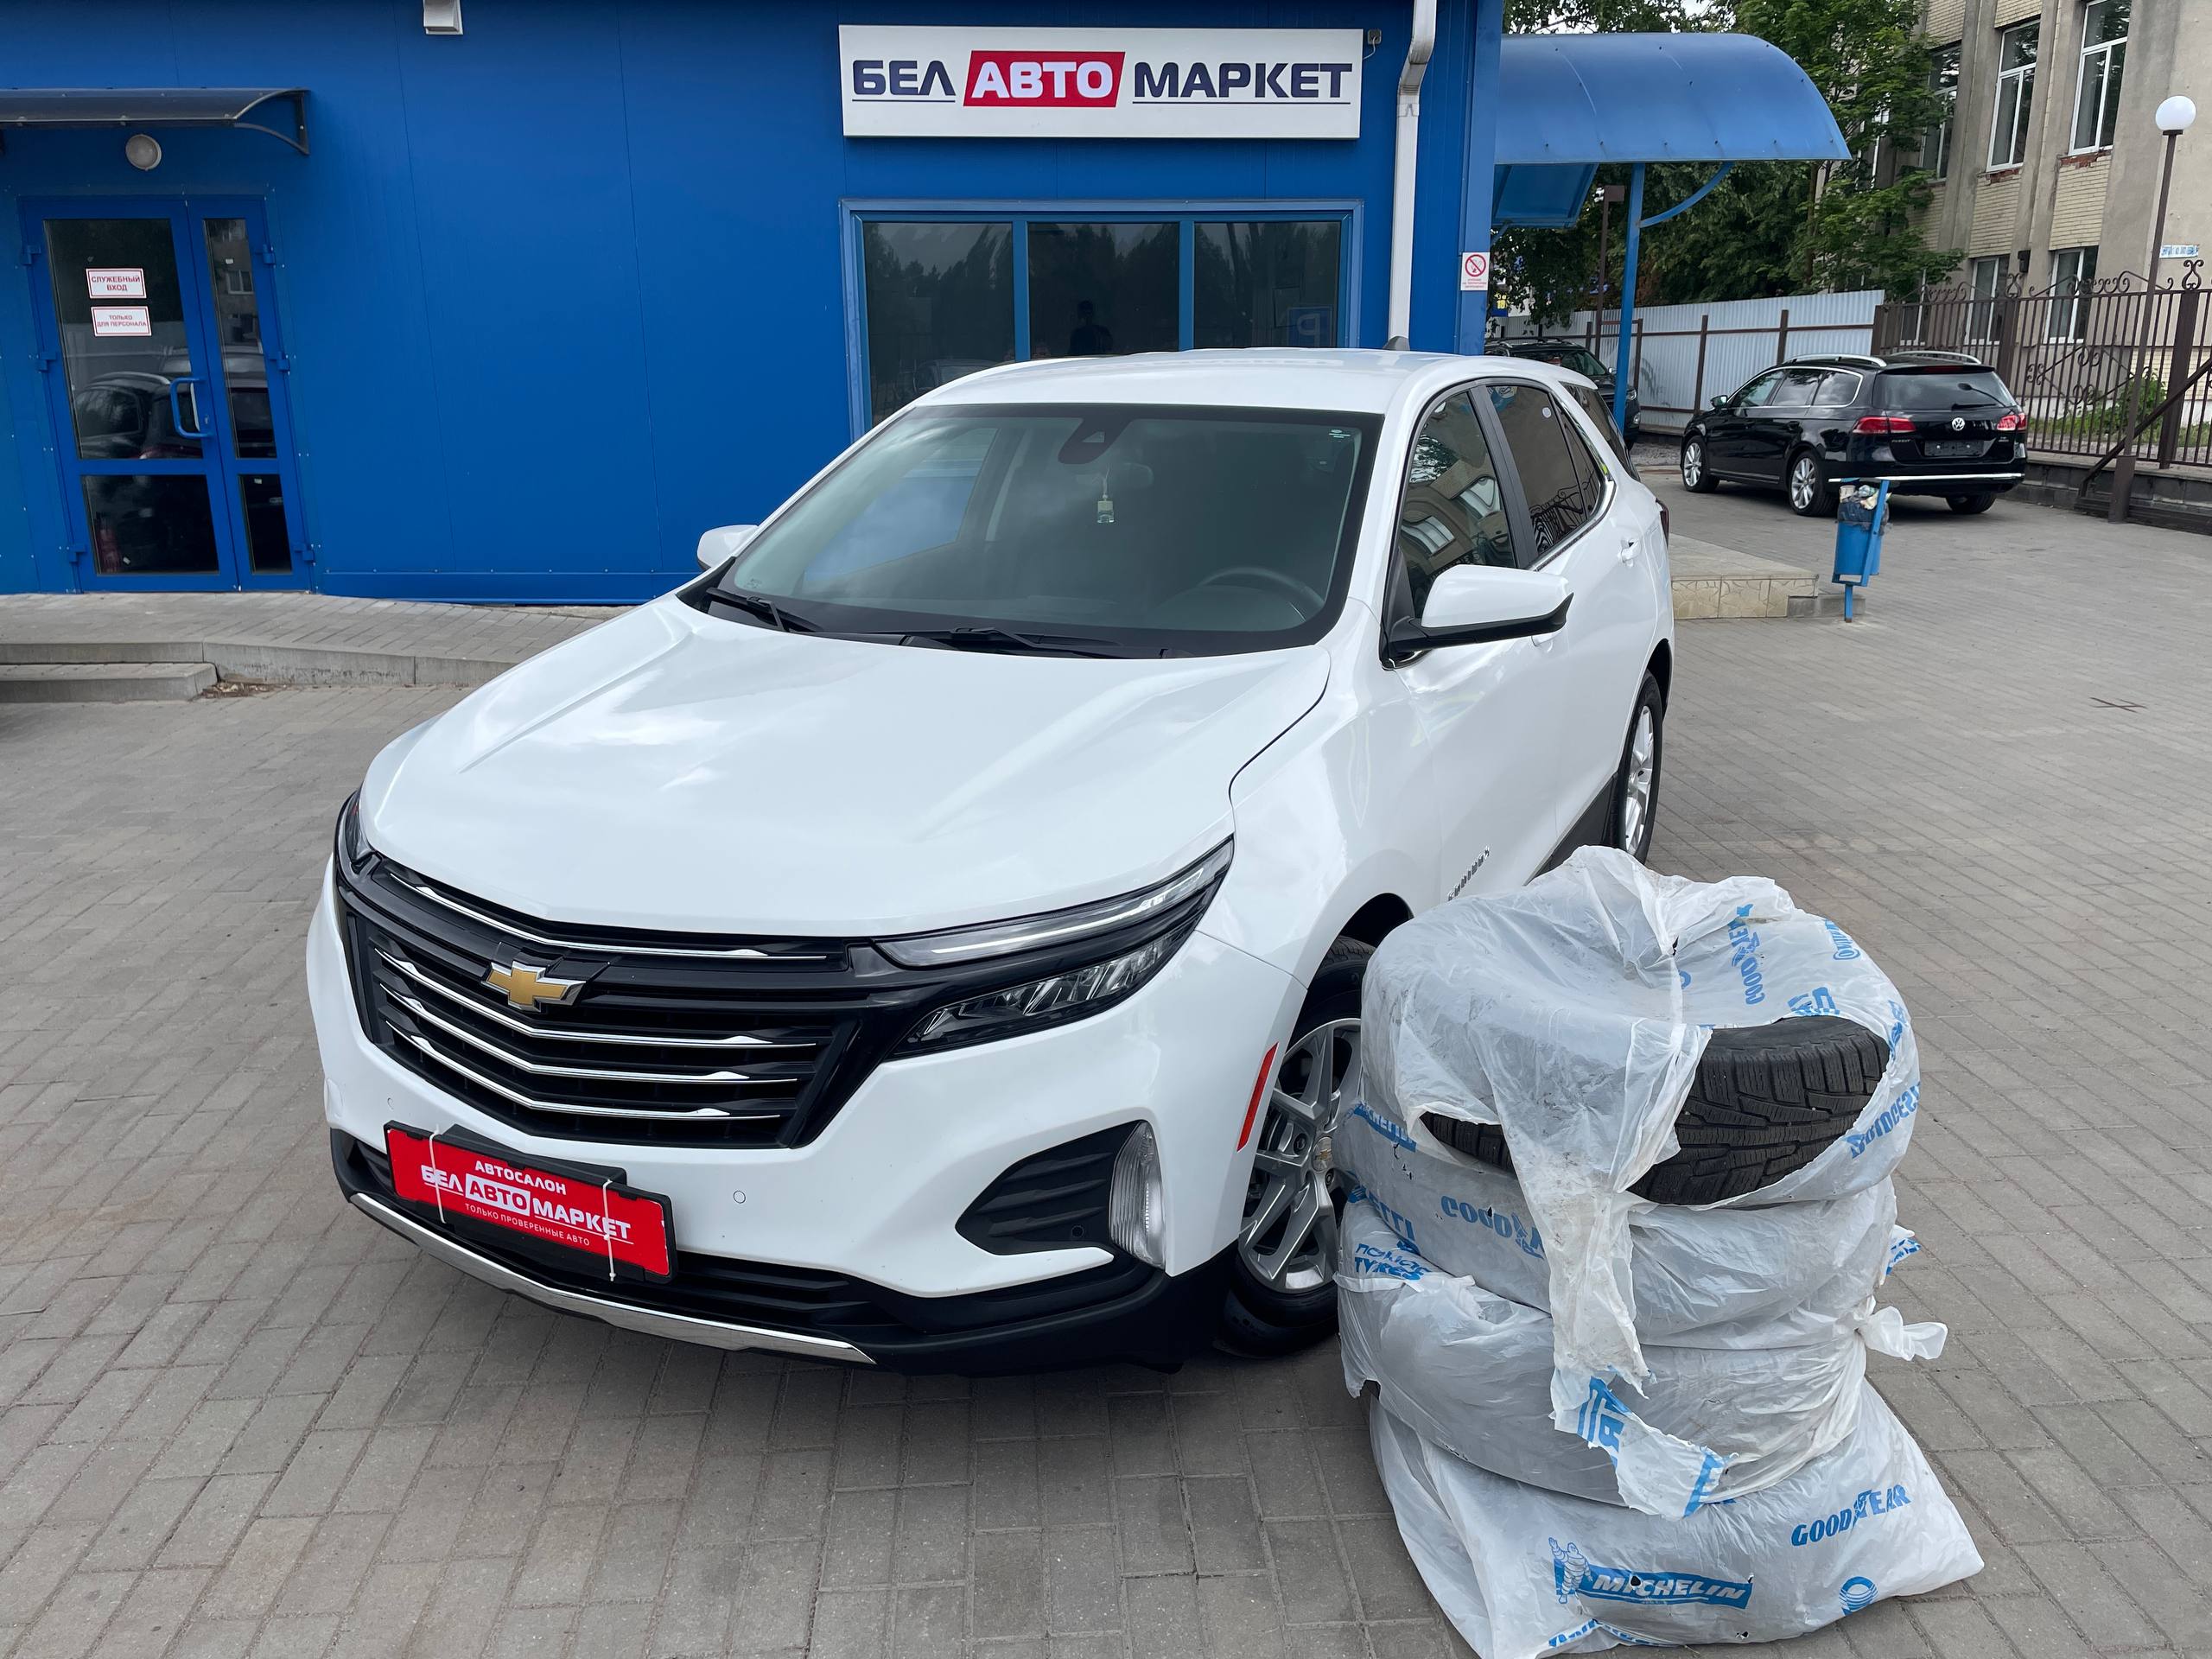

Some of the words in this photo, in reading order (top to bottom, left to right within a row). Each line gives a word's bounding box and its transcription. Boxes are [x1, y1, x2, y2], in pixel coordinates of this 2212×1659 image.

[852, 60, 956, 97] БЕЛ
[970, 61, 1113, 99] АВТО
[1135, 62, 1353, 99] МАРКЕТ
[474, 1160, 567, 1195] АВТОСАЛОН
[420, 1164, 464, 1192] БЕЛ
[469, 1180, 527, 1210] АВТО
[532, 1198, 632, 1240] МАРКЕТ
[465, 1203, 499, 1220] ТОЛЬКО
[500, 1214, 564, 1239] ПРОВЕРЕННЫЕ
[566, 1233, 590, 1246] АВТО
[1790, 1484, 1911, 1547] GOODYEAR
